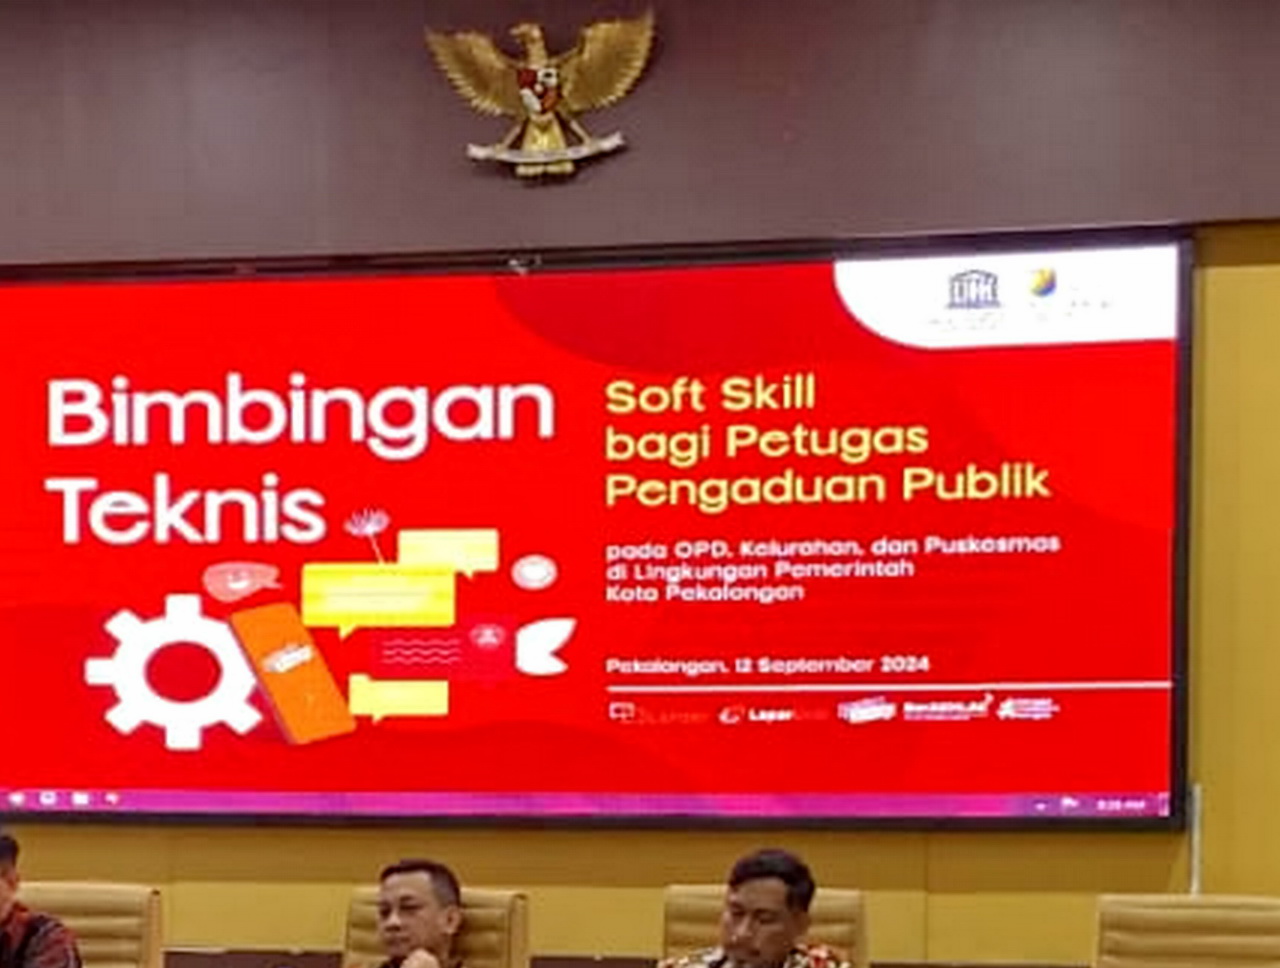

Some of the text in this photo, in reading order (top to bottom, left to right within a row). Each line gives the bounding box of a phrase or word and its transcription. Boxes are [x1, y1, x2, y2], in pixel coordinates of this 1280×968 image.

[605, 373, 816, 414] Soft Skill
[47, 371, 555, 460] Bimbingan
[605, 424, 930, 468] bagi Petugas
[43, 472, 327, 545] Teknis
[605, 462, 1052, 514] Pengaduan Publik
[605, 541, 668, 562] pada
[871, 536, 919, 556] dan
[924, 534, 1062, 555] Puskesmas
[606, 559, 915, 583] di Lingkungan Pemerintah
[606, 582, 806, 604] Kota Pekalongan
[734, 657, 753, 674] 12
[757, 656, 874, 676] September
[879, 655, 931, 673] 2024
